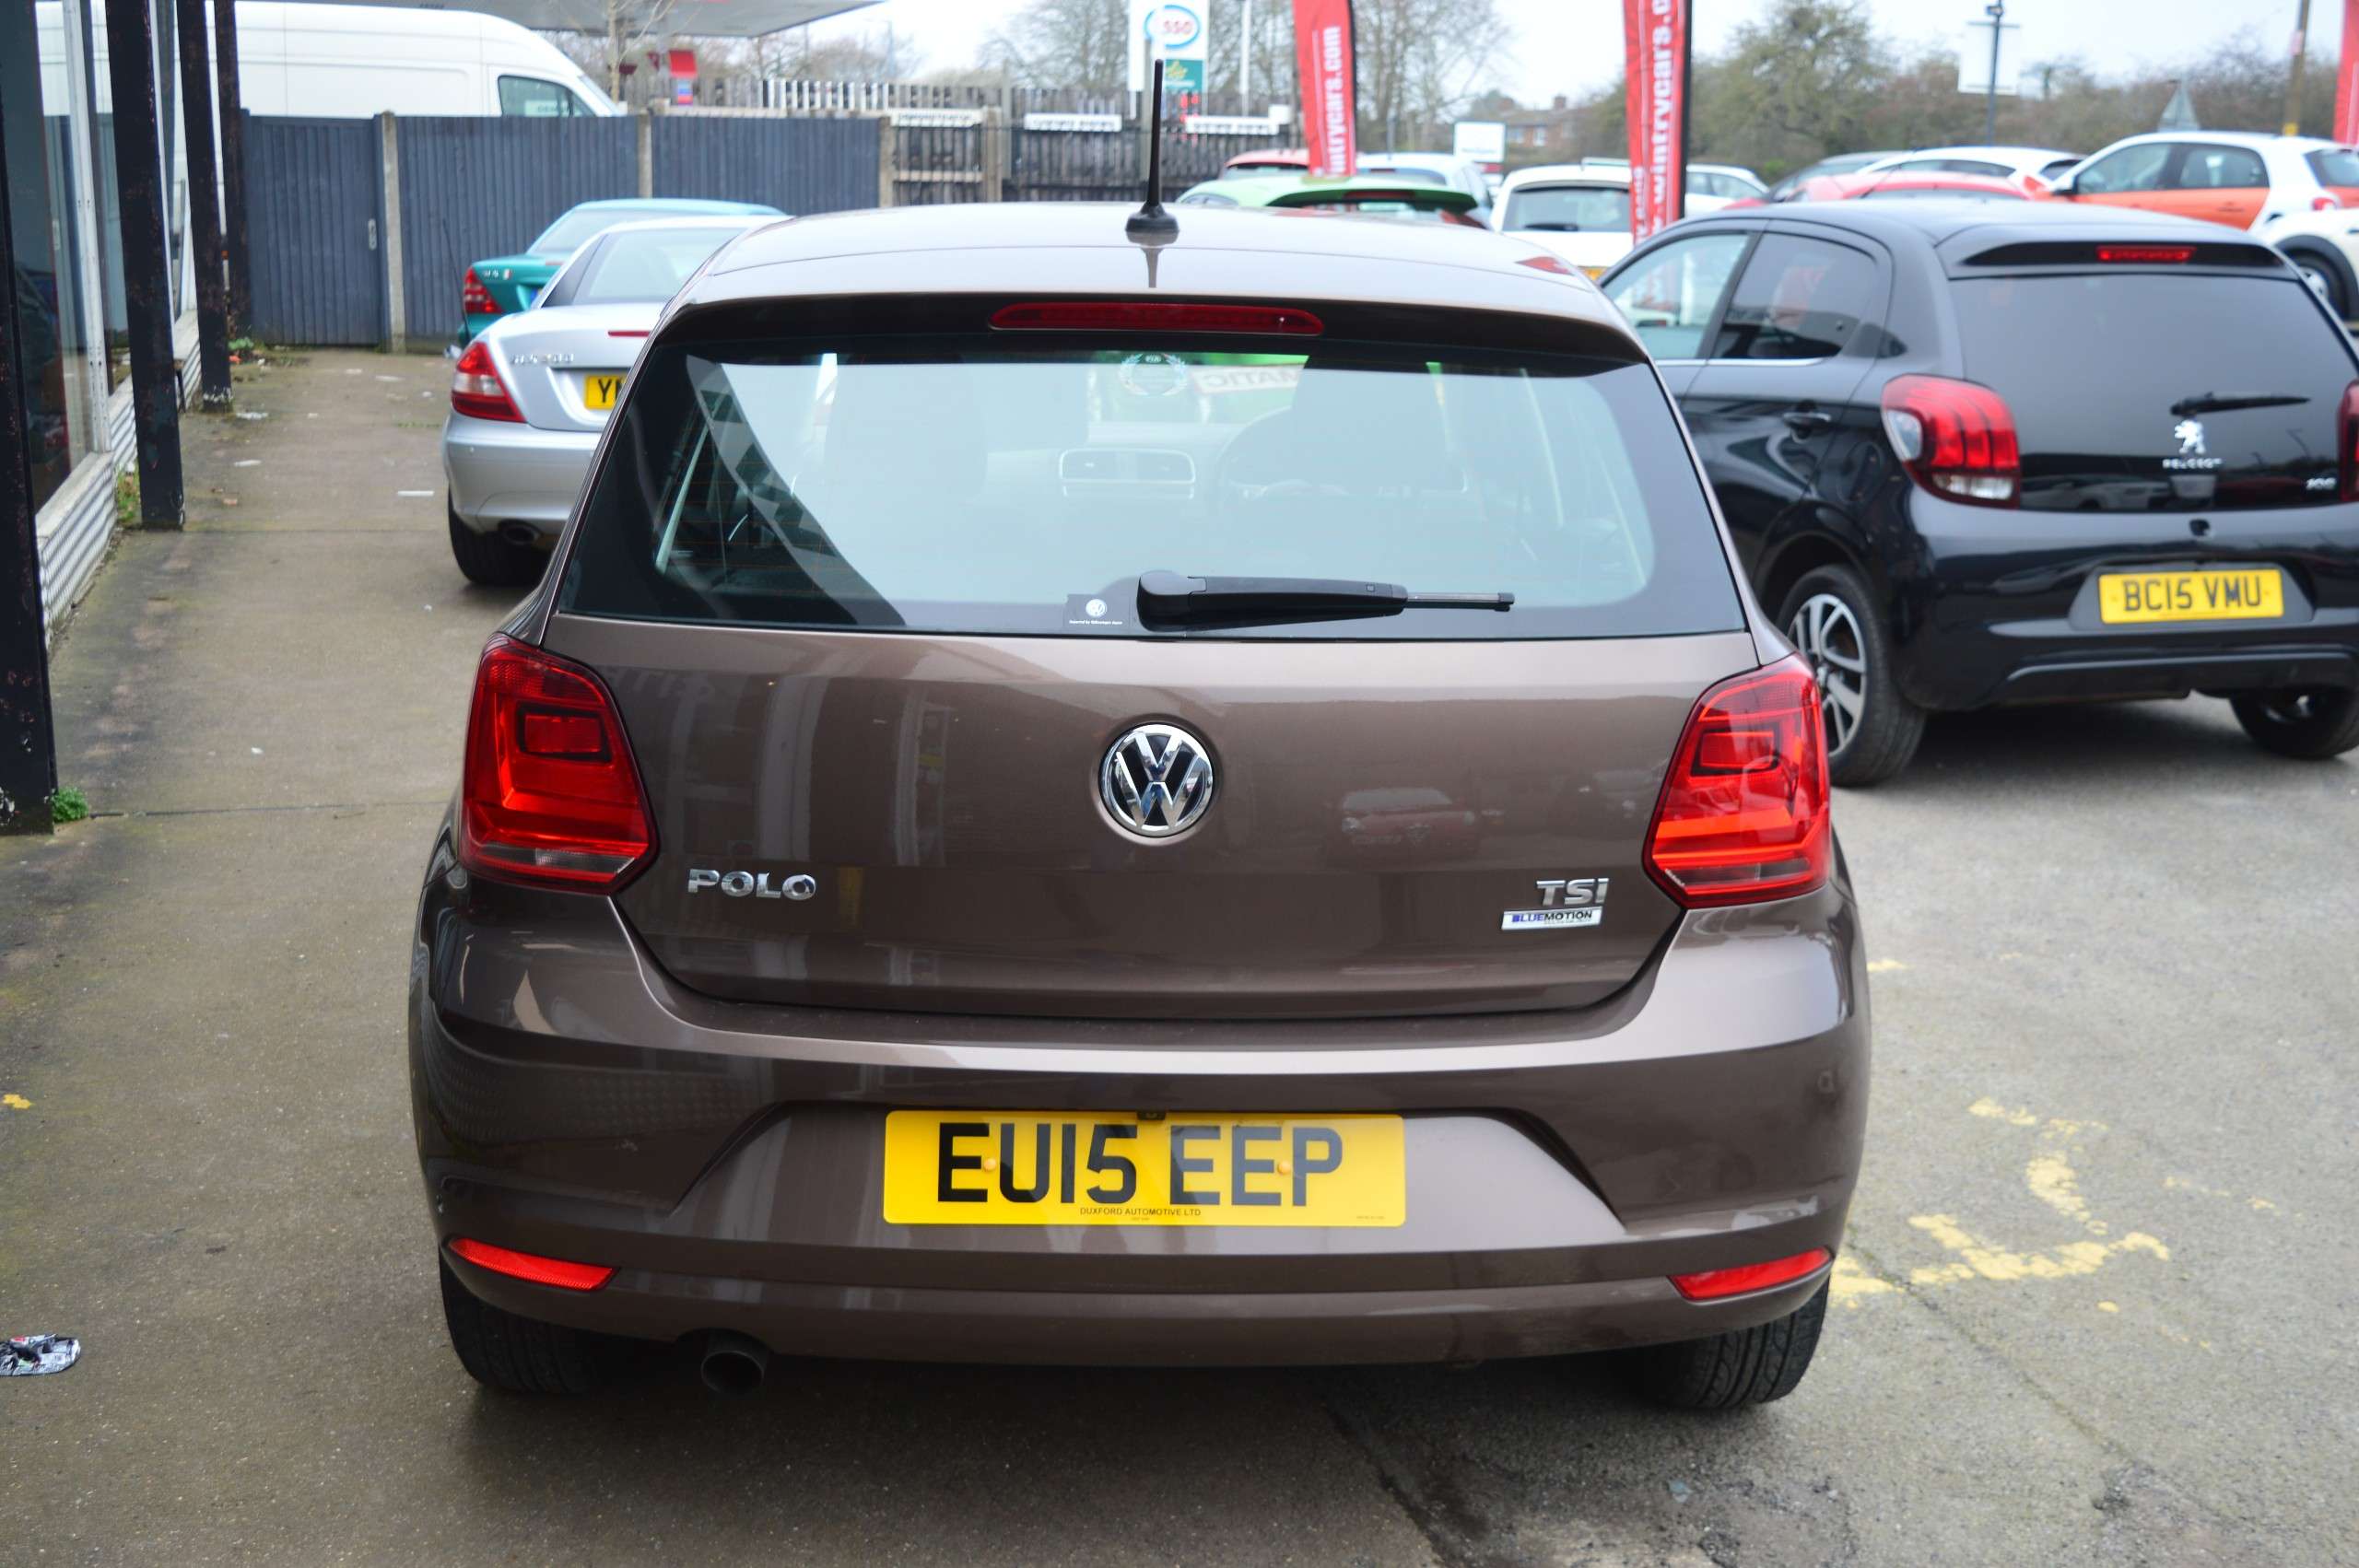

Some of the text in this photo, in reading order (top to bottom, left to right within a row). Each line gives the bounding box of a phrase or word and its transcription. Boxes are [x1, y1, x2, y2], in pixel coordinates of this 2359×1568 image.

[2123, 575, 2261, 612] BC15 VMU
[687, 868, 816, 901] POLO
[1512, 909, 1592, 923] BLUEMOTION
[937, 1121, 1344, 1207] EU15 EEP
[1079, 1207, 1202, 1217] DUXFORD AUTOMOTIVE LTD
